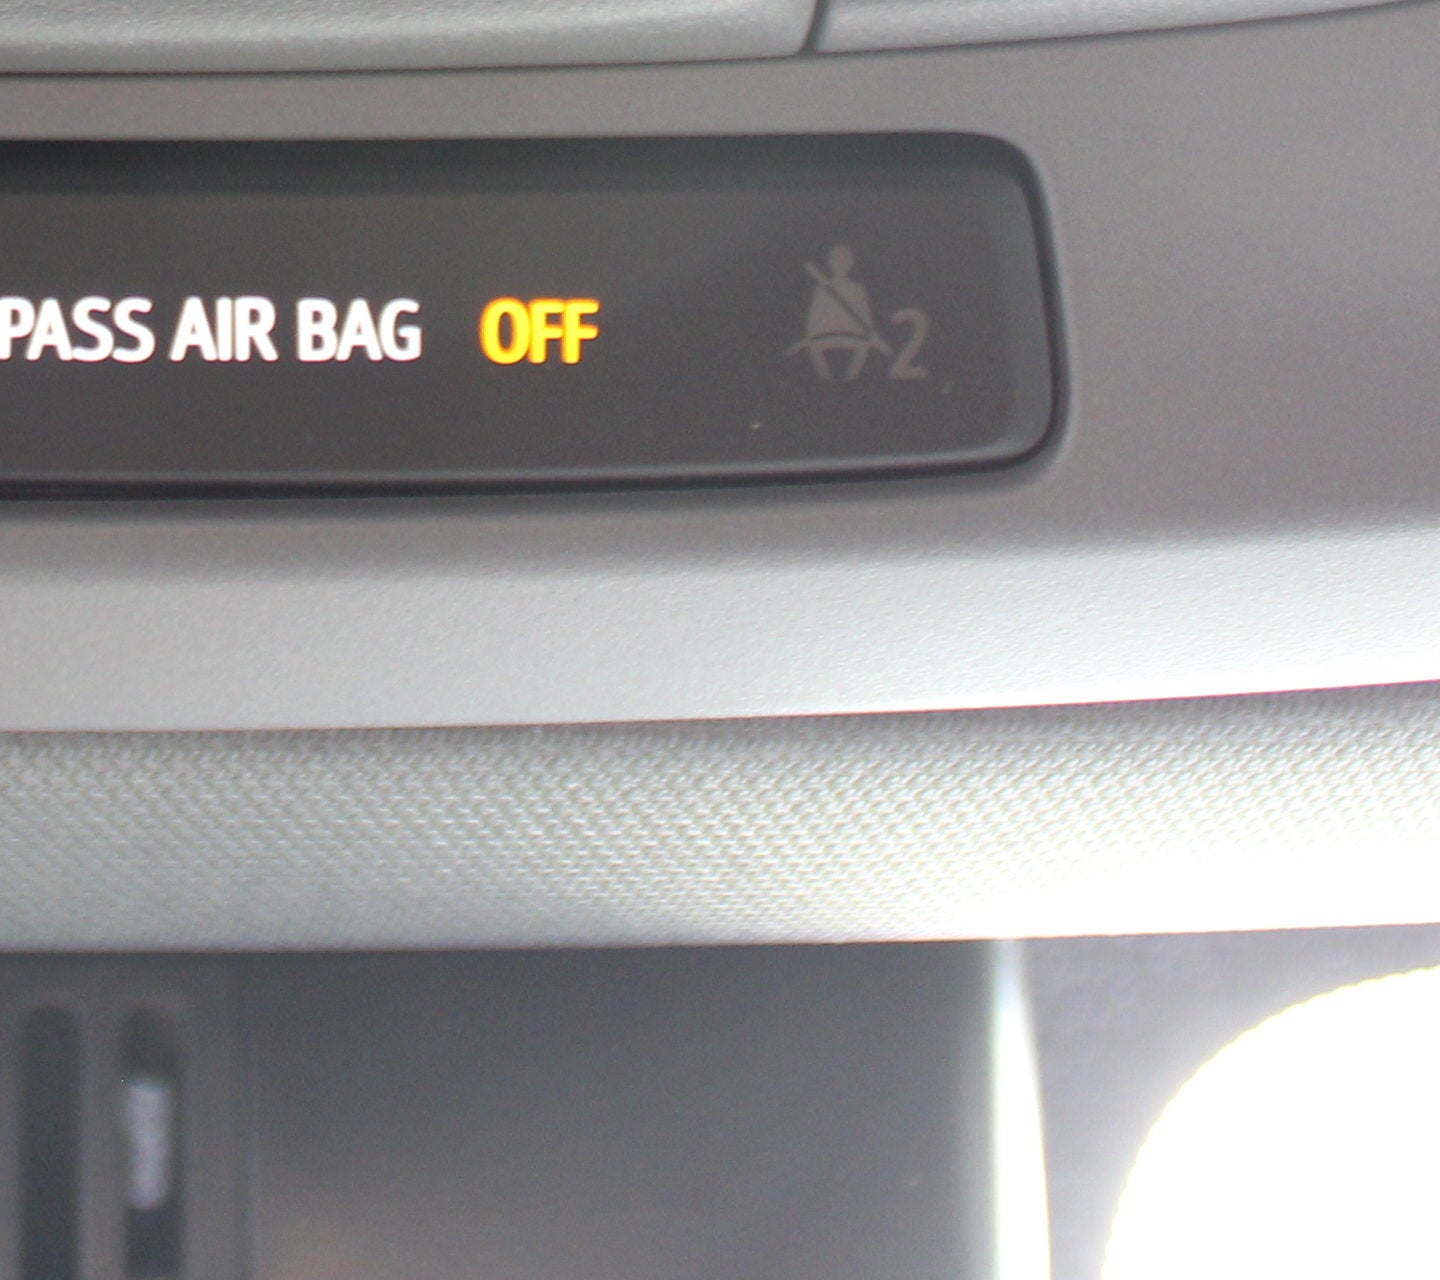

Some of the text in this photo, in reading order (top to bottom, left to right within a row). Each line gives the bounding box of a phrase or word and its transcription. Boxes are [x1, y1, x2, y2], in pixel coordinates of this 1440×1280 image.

[169, 297, 278, 361] AIR
[296, 298, 422, 361] BAG
[480, 299, 599, 363] OFF
[889, 309, 928, 379] 2
